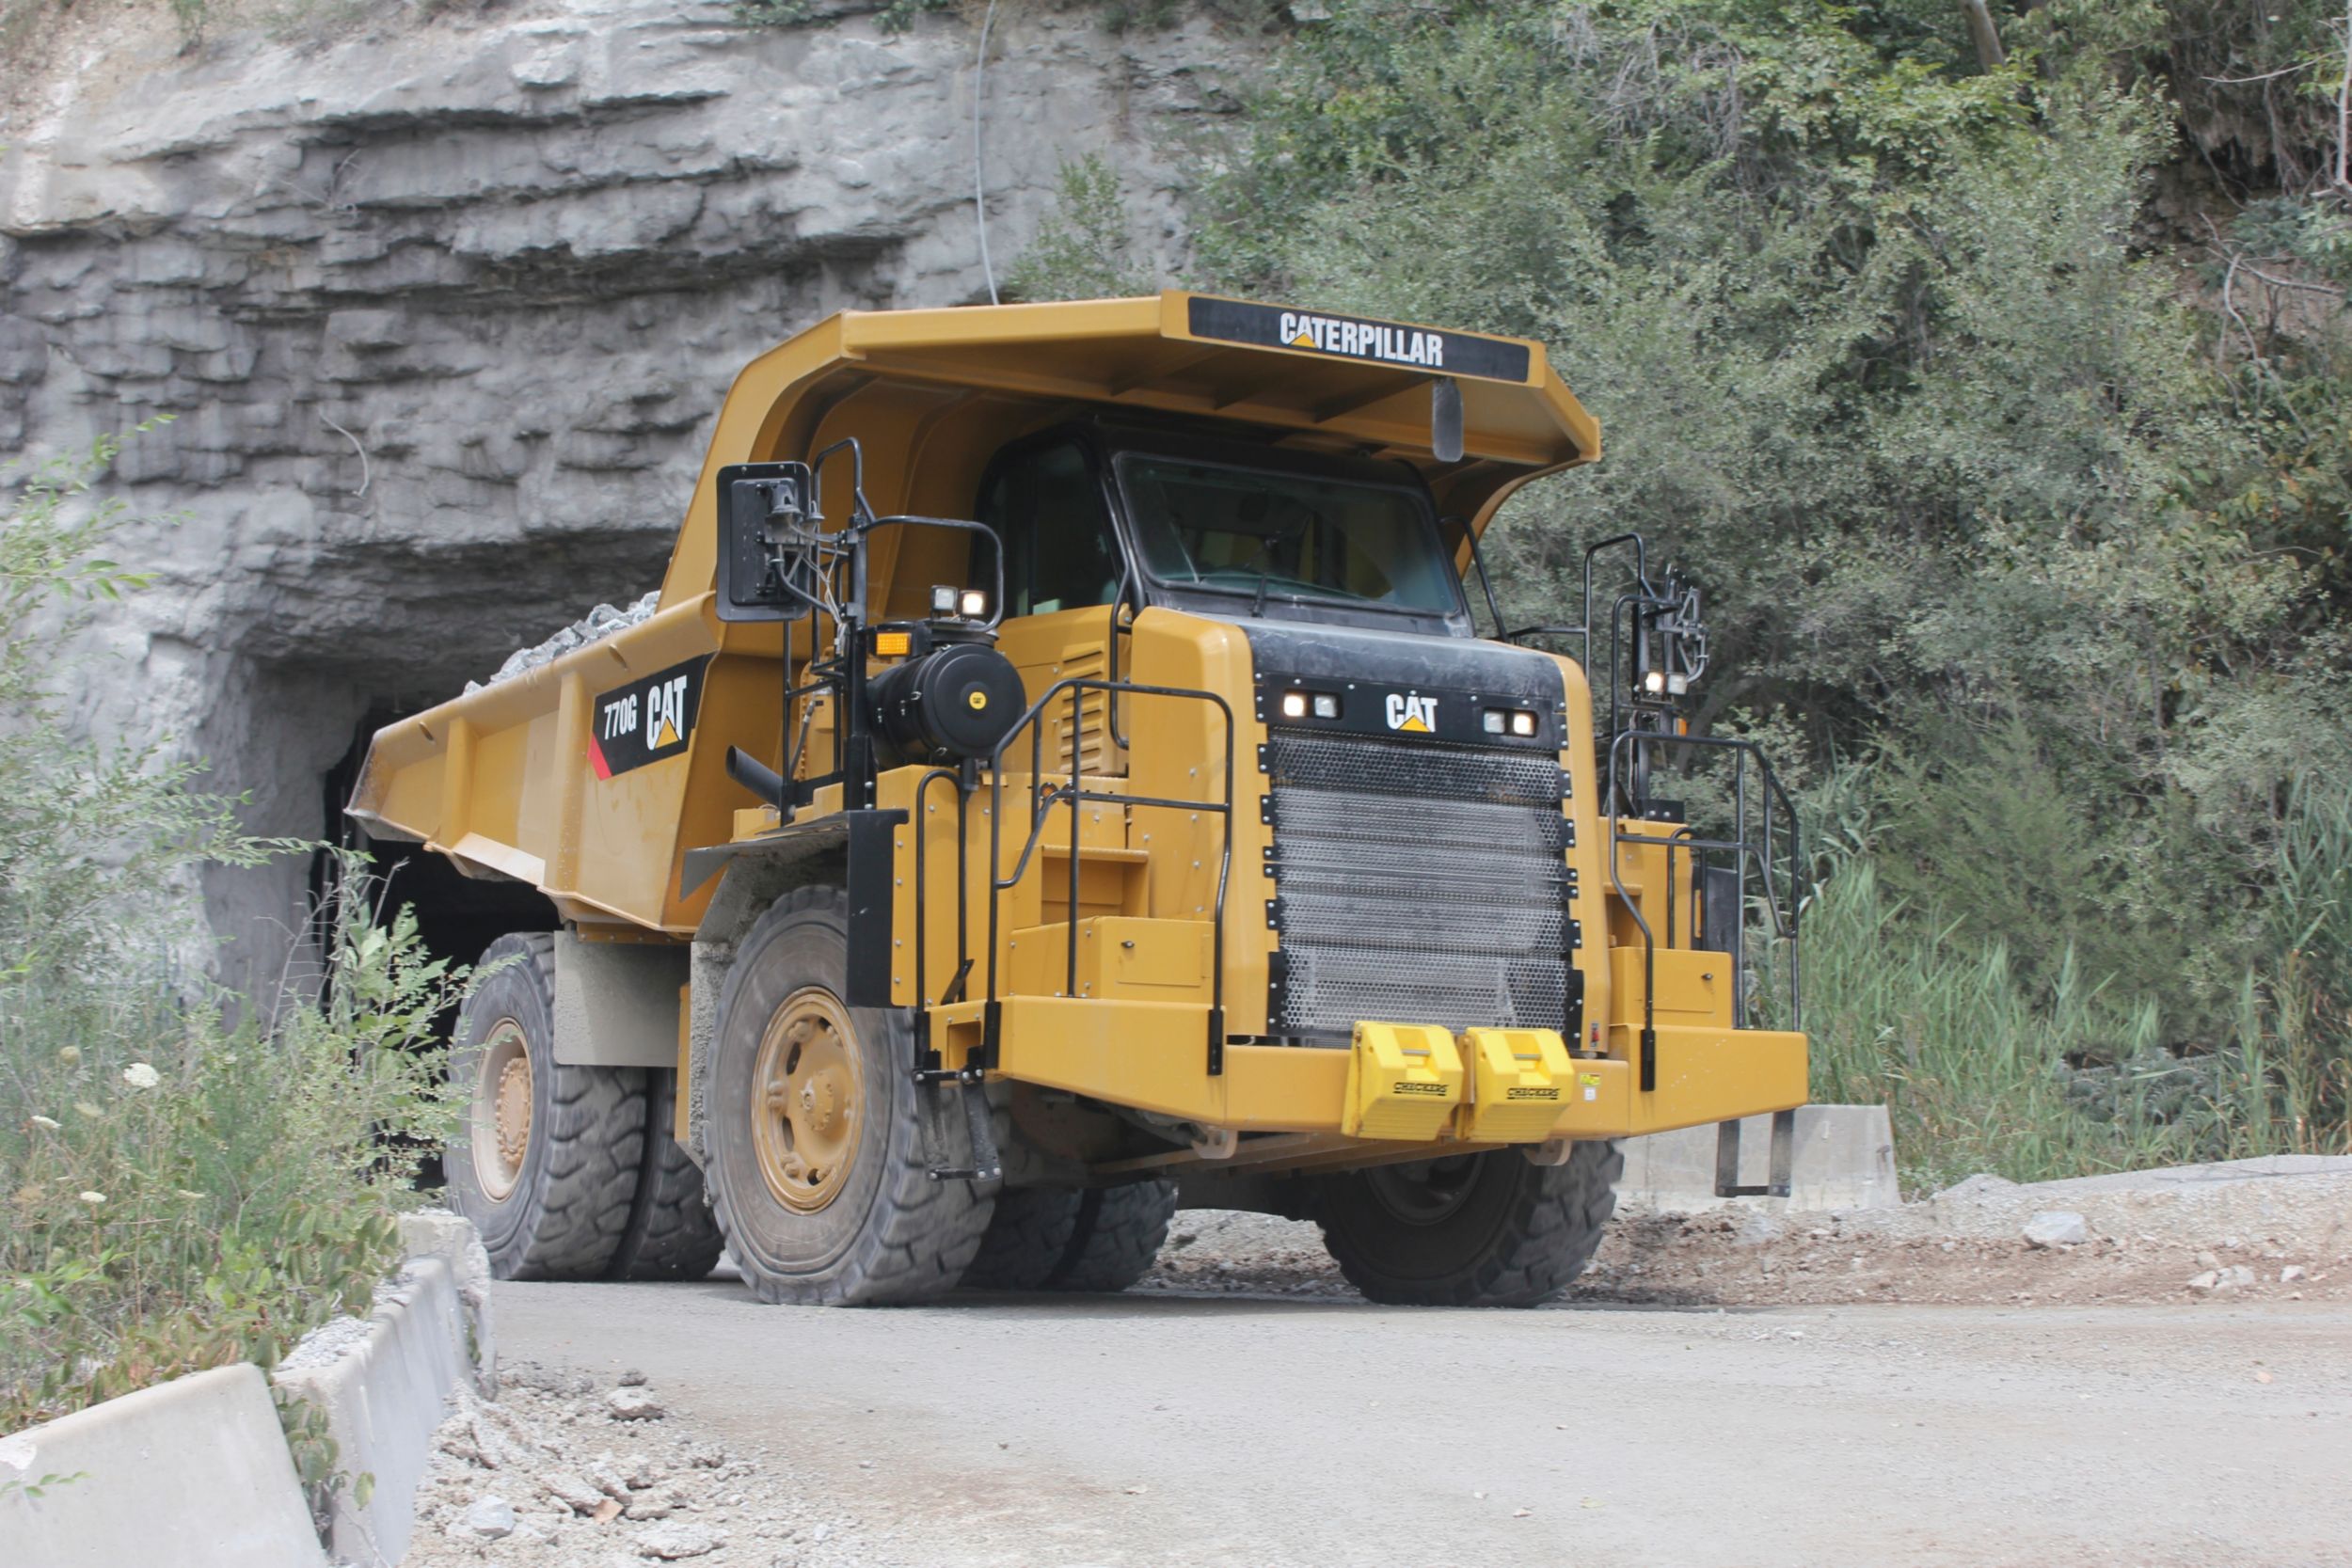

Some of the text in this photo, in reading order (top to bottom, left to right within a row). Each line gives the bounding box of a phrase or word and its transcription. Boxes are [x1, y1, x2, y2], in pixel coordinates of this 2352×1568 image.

[1280, 312, 1443, 367] CATERPILLAR
[604, 674, 688, 751] 770G CAT
[1386, 693, 1438, 733] CAT
